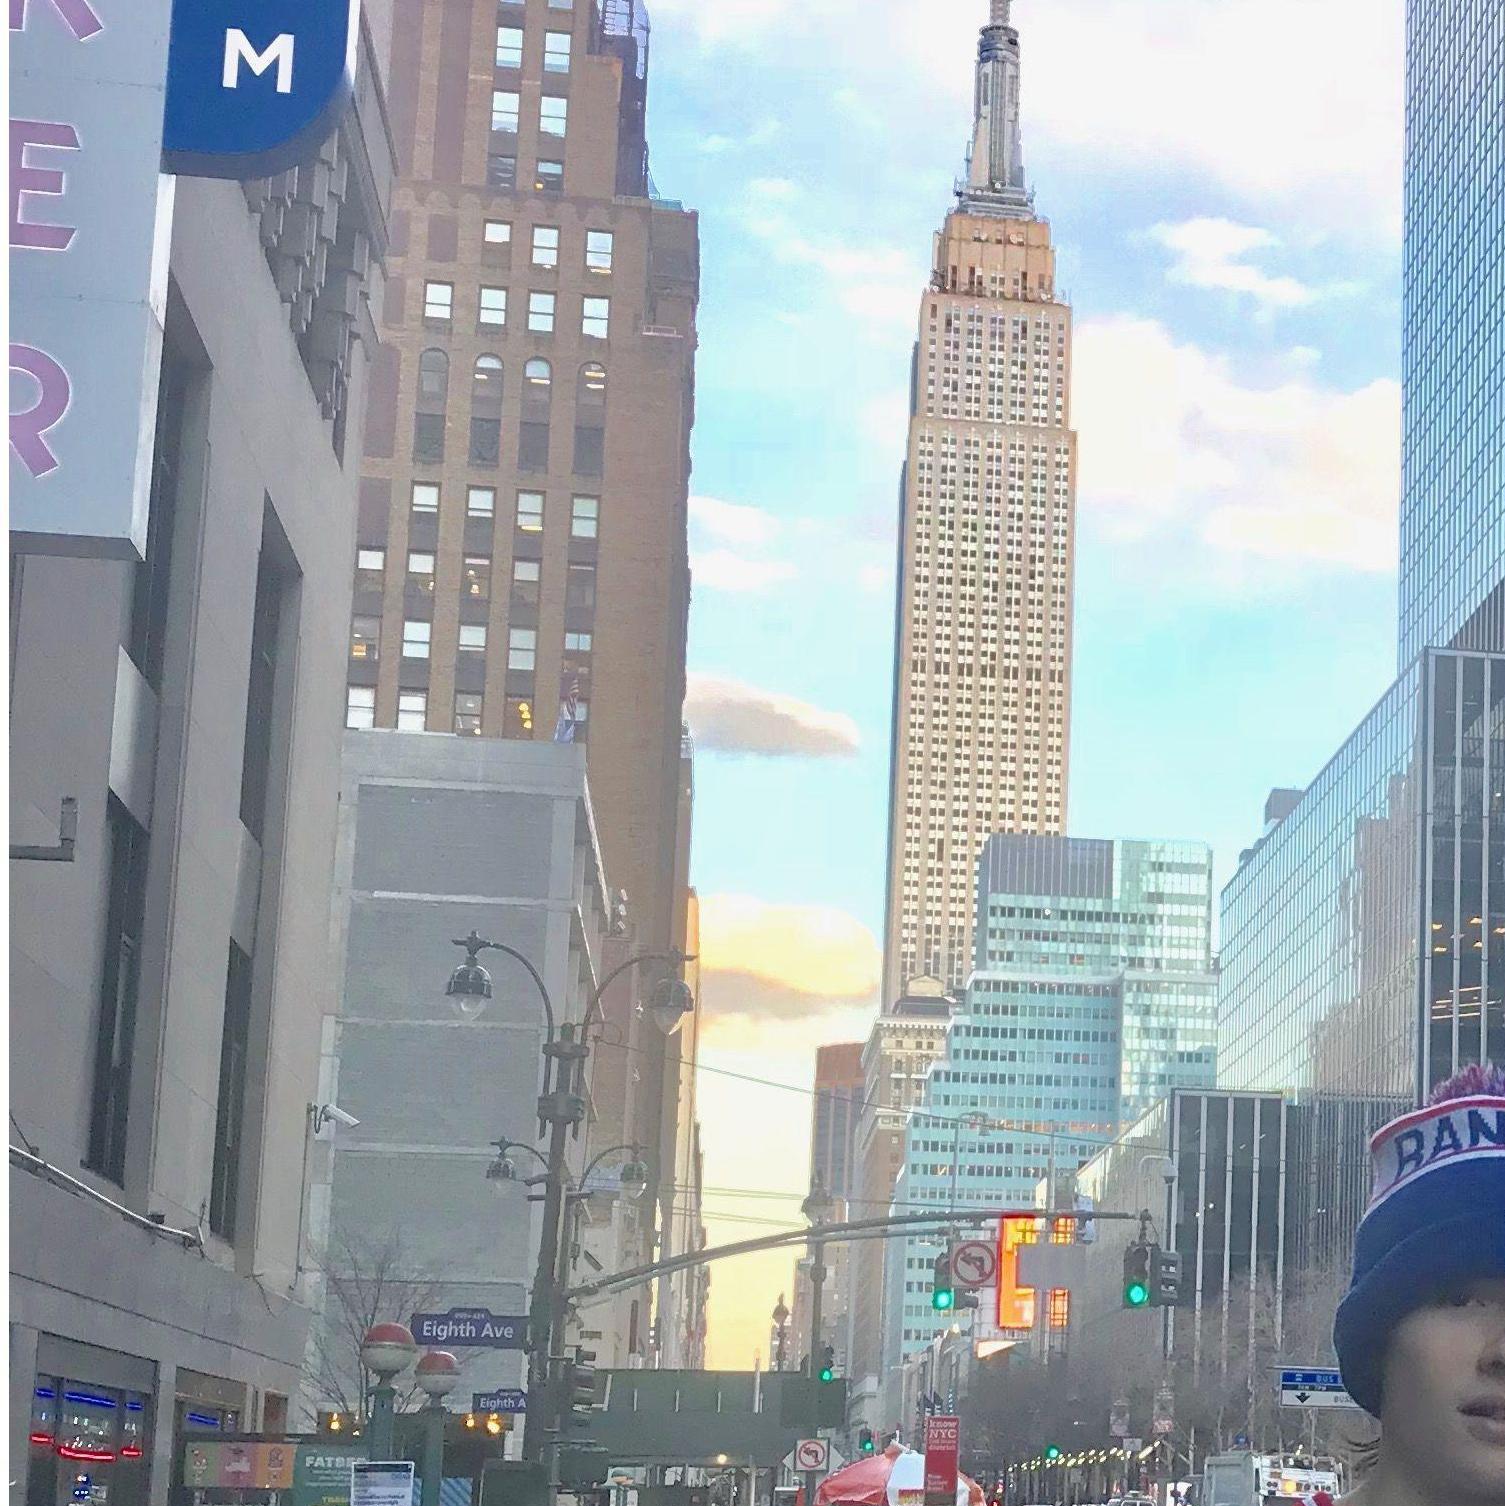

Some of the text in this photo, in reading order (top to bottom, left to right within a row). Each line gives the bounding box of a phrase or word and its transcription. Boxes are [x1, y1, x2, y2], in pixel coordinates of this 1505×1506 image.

[423, 1320, 514, 1341] Eighth Ave
[480, 1397, 515, 1410] Eighth
[929, 1419, 958, 1428] know
[929, 1429, 958, 1439] NYC
